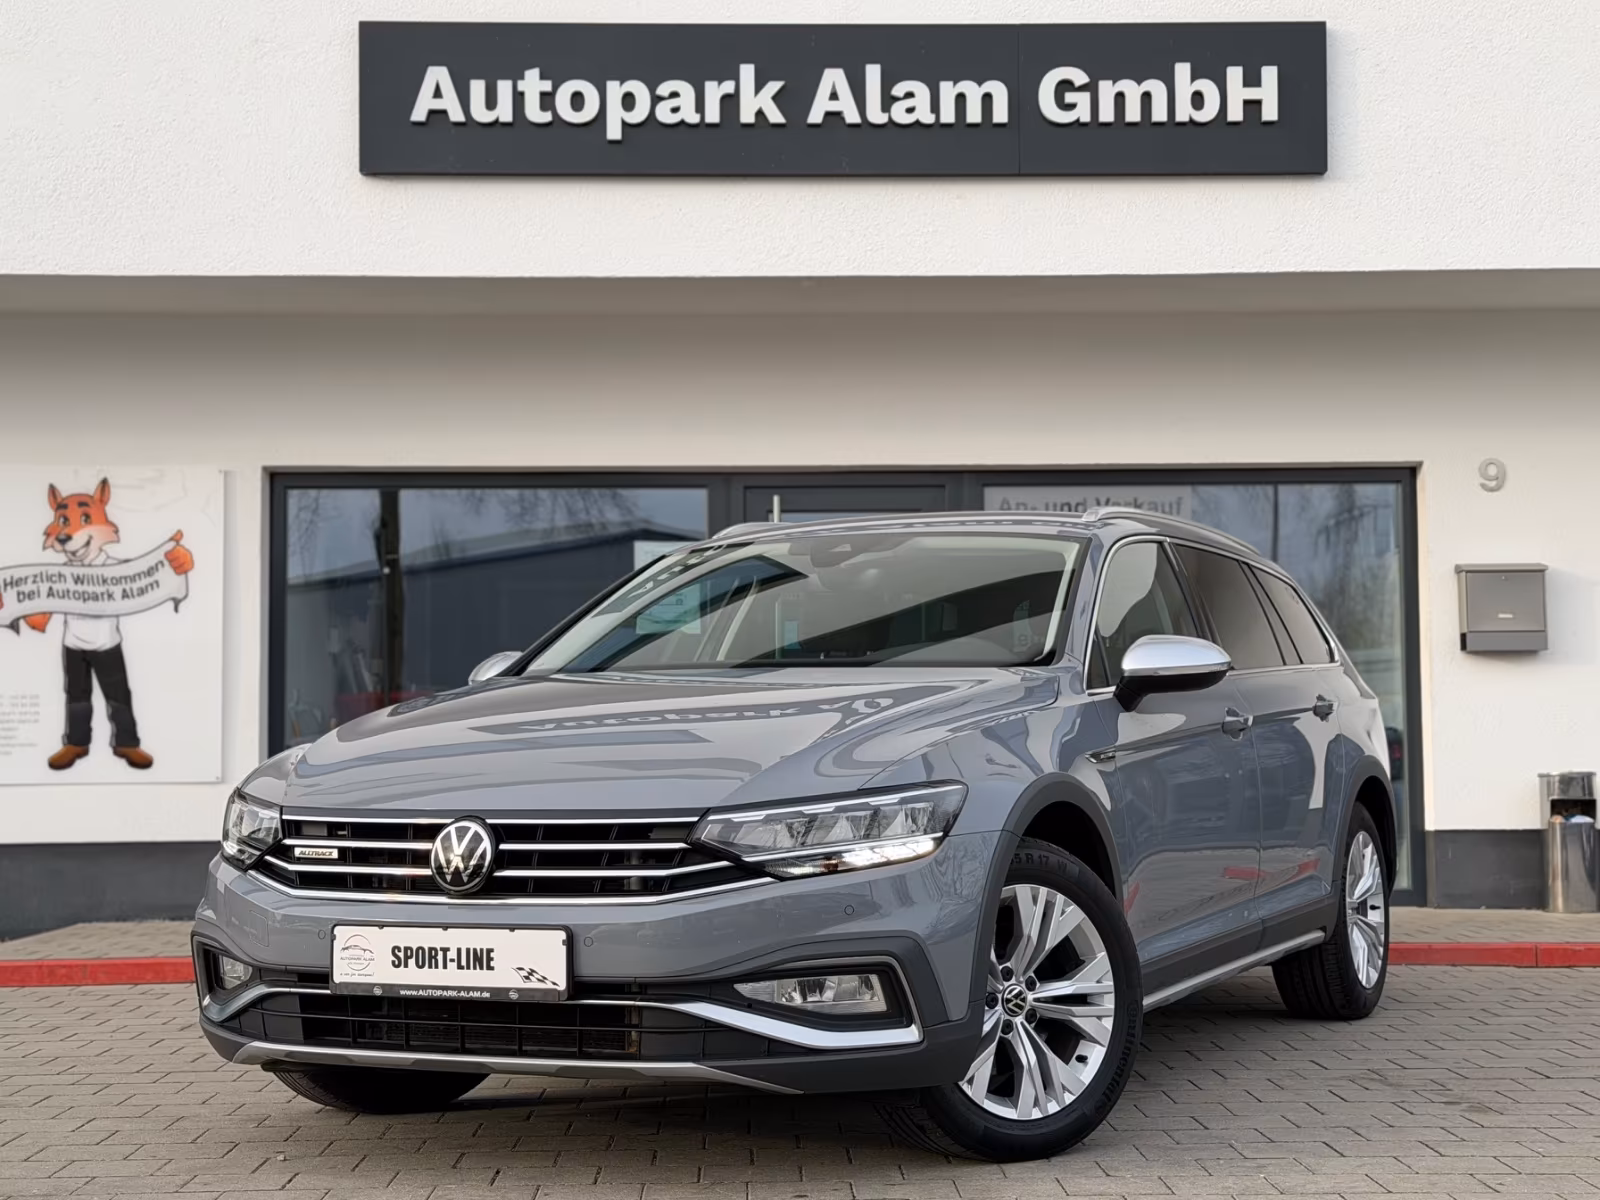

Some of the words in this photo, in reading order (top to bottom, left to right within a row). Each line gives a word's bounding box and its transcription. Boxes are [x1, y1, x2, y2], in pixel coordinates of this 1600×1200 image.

[410, 64, 786, 140] Autopark
[807, 64, 1009, 126] Alam
[1038, 62, 1279, 124] GmbH
[1478, 458, 1507, 492] 9
[1044, 497, 1087, 512] und
[3, 570, 67, 593] Herzlich
[71, 559, 165, 587] Willkommen
[16, 586, 41, 603] bei
[46, 586, 116, 604] Autopark
[121, 579, 160, 600] Alam
[298, 850, 334, 858] ALLTRACK
[1025, 853, 1034, 865] R
[1038, 854, 1050, 867] 17
[391, 945, 495, 971] SPORT-LINE
[400, 988, 491, 998] www.AUTOPARK-ALAM.de
